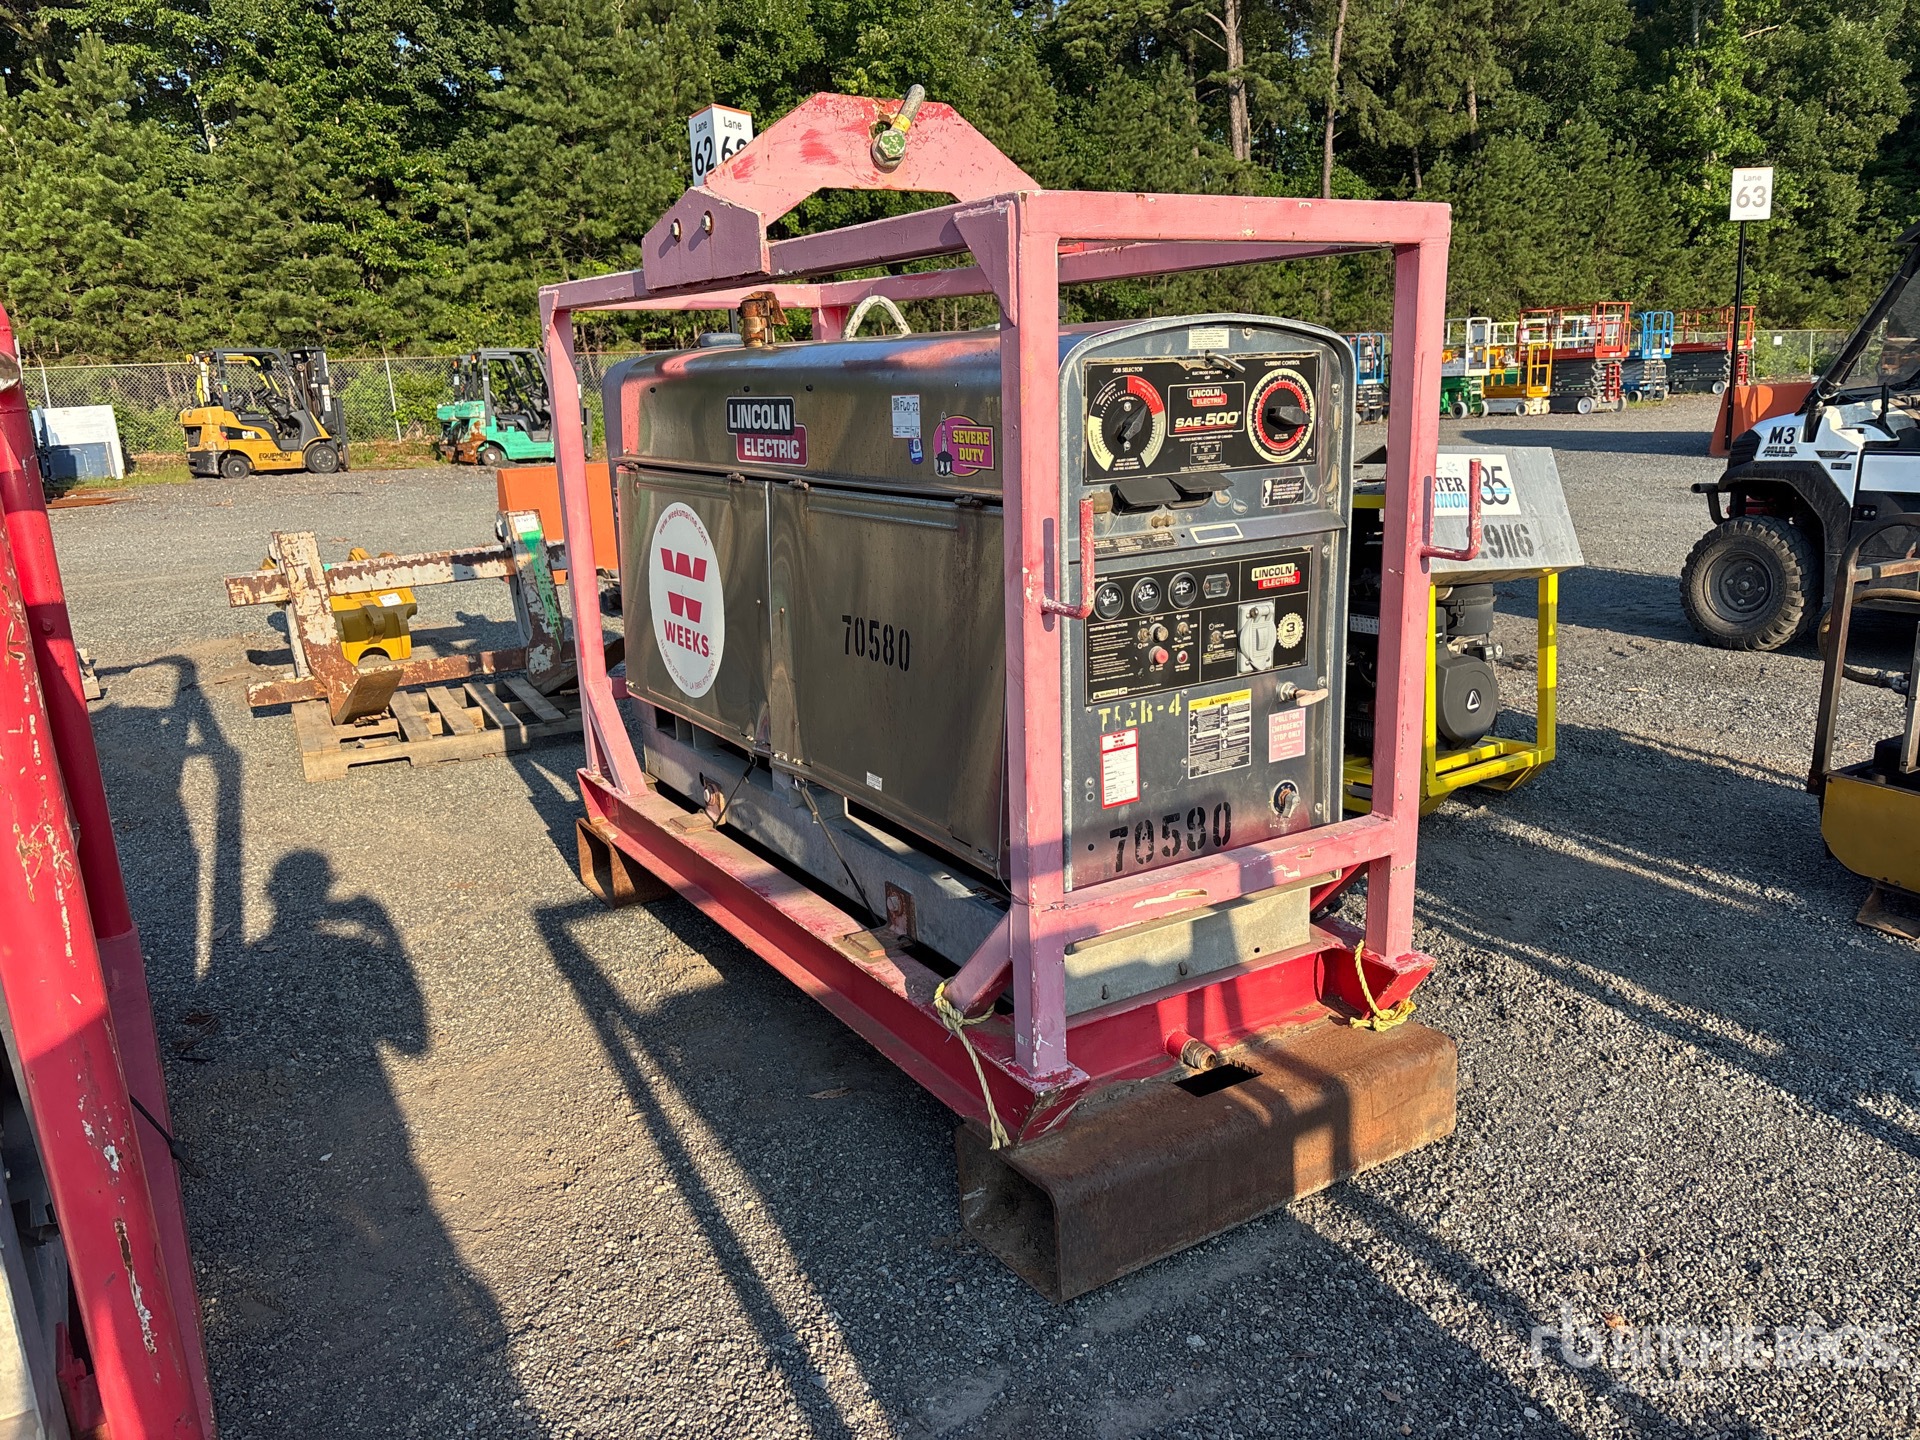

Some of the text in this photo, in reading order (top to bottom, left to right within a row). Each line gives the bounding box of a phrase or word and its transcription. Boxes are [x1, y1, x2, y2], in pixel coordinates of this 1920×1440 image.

[695, 120, 708, 133] Lane
[723, 116, 742, 130] Lane
[695, 136, 714, 176] 62
[721, 135, 747, 162] 6
[1736, 185, 1767, 208] 63
[1189, 388, 1220, 398] LINCOLN
[1196, 397, 1223, 405] ELECTRIC
[728, 403, 792, 431] LINCOLN
[242, 431, 255, 439] CAT
[952, 430, 990, 446] SEVERE
[1768, 426, 1796, 445] M3
[743, 437, 800, 460] ELECTRIC
[958, 447, 985, 463] DUTY
[1762, 446, 1798, 454] MULE
[1435, 477, 1466, 492] TER
[1434, 493, 1468, 508] NNON
[658, 508, 708, 546] www.weeksmarine.com
[1465, 523, 1535, 559] 9116
[1254, 565, 1292, 579] LINCOLN
[1262, 575, 1296, 587] ELECTRIC
[1286, 622, 1295, 632] 3
[663, 619, 710, 658] WEEKS
[842, 614, 911, 672] 70580
[1215, 696, 1232, 704] WARNING
[1274, 712, 1300, 724] PULL FOR
[1271, 720, 1303, 733] EMERGENCY
[1273, 730, 1301, 742] STOP ONLY
[1109, 801, 1232, 873] 70580
